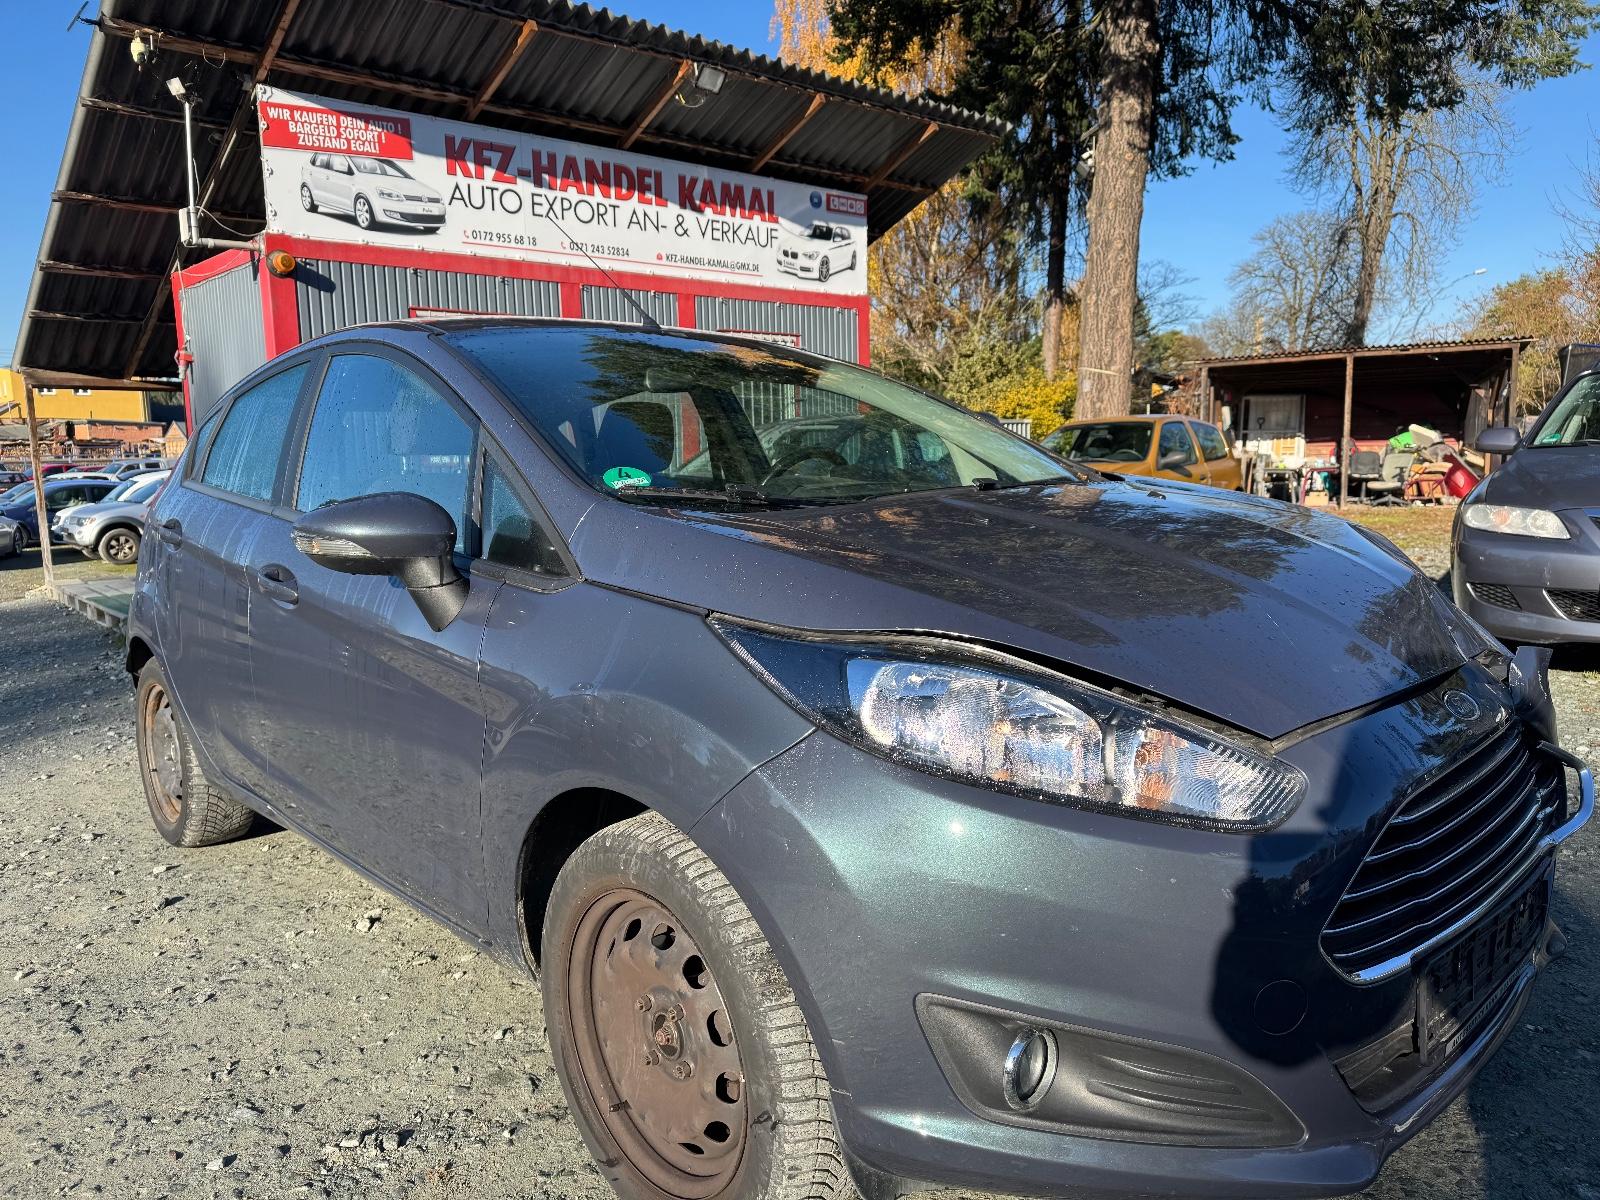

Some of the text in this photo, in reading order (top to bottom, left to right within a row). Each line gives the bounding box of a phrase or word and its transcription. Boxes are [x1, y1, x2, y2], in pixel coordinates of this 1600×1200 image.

[267, 106, 402, 134] WIR KAUFEN DEIN AUTO !
[288, 122, 386, 143] BARGELD SOFORT !
[297, 134, 380, 154] ZUSTAND EGAL!
[444, 133, 780, 224] KFZ-HANDEL KAMAL
[448, 182, 779, 248] AUTO EXPORT AN- & VERKAUF
[471, 230, 537, 247] 0172 955 68 18
[590, 243, 605, 254] 243
[607, 245, 630, 257] 52834
[665, 253, 760, 272] KFZ-HANDEL-KAMAL@GMX.DE
